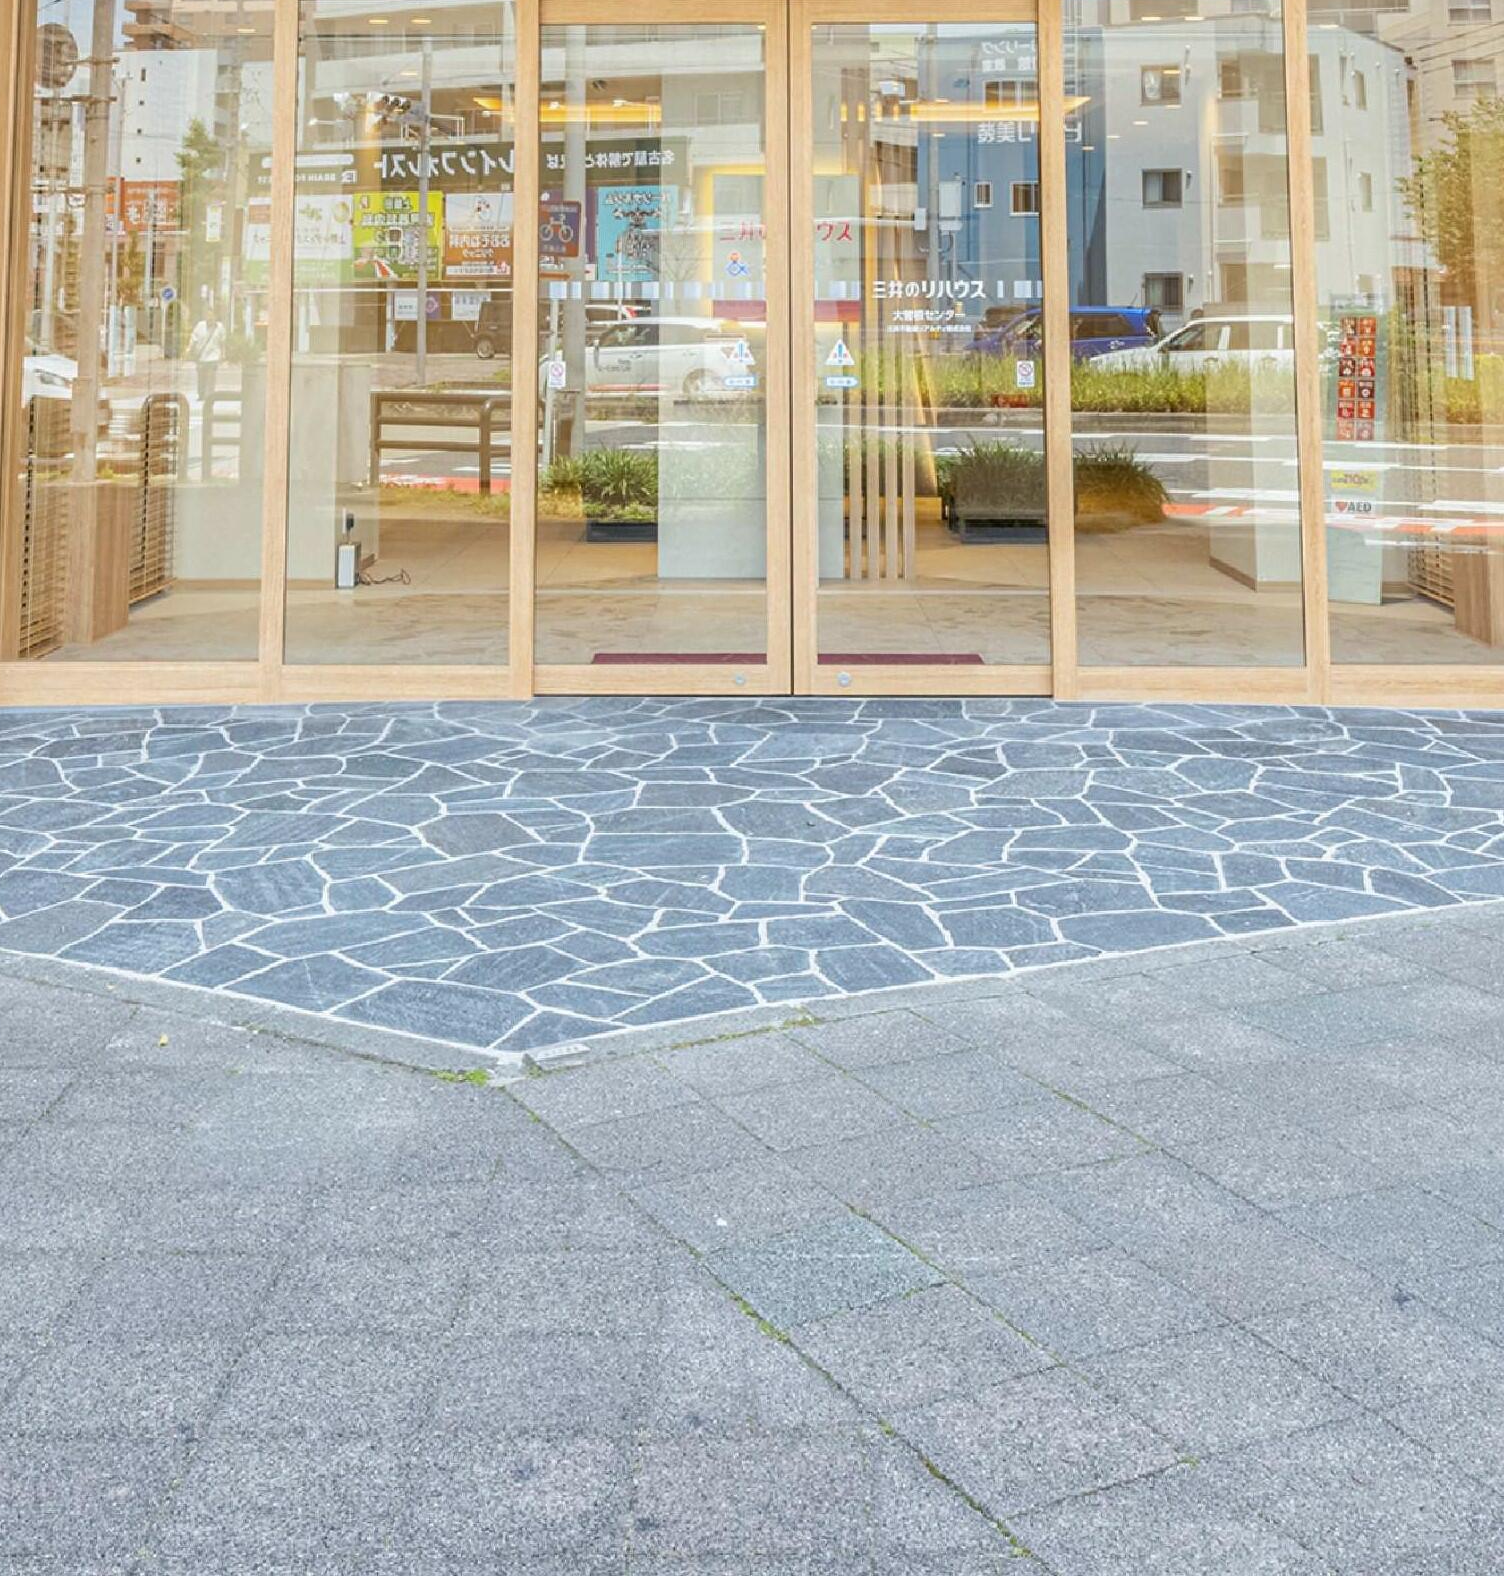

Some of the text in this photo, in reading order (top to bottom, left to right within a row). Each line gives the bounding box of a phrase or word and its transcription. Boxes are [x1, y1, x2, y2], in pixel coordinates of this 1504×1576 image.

[872, 279, 987, 299] 三井のリハウス
[1347, 500, 1373, 513] AED
